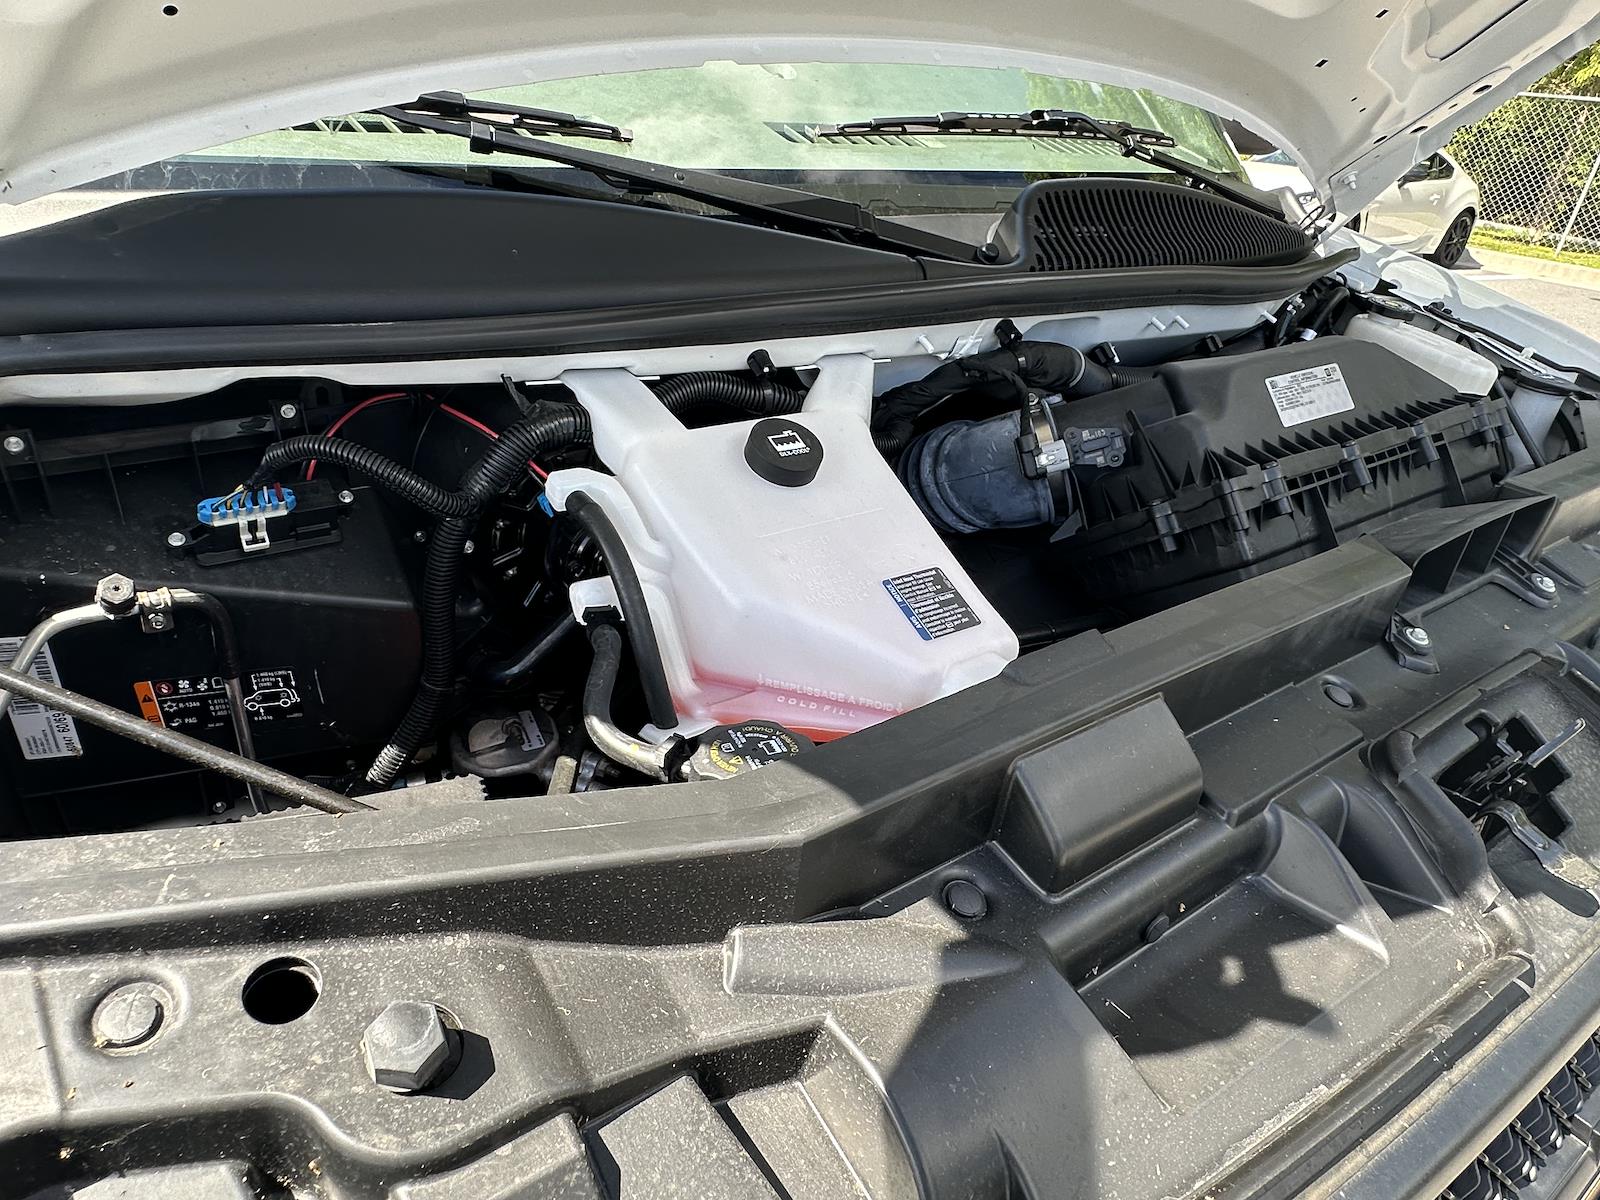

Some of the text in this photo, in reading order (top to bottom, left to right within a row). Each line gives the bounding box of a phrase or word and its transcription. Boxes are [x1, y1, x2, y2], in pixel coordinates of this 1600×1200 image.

[885, 583, 904, 603] NOTICE
[765, 679, 846, 703] REMPLISSAGE
[859, 698, 894, 712] FROID
[776, 695, 856, 718] COLD FILL
